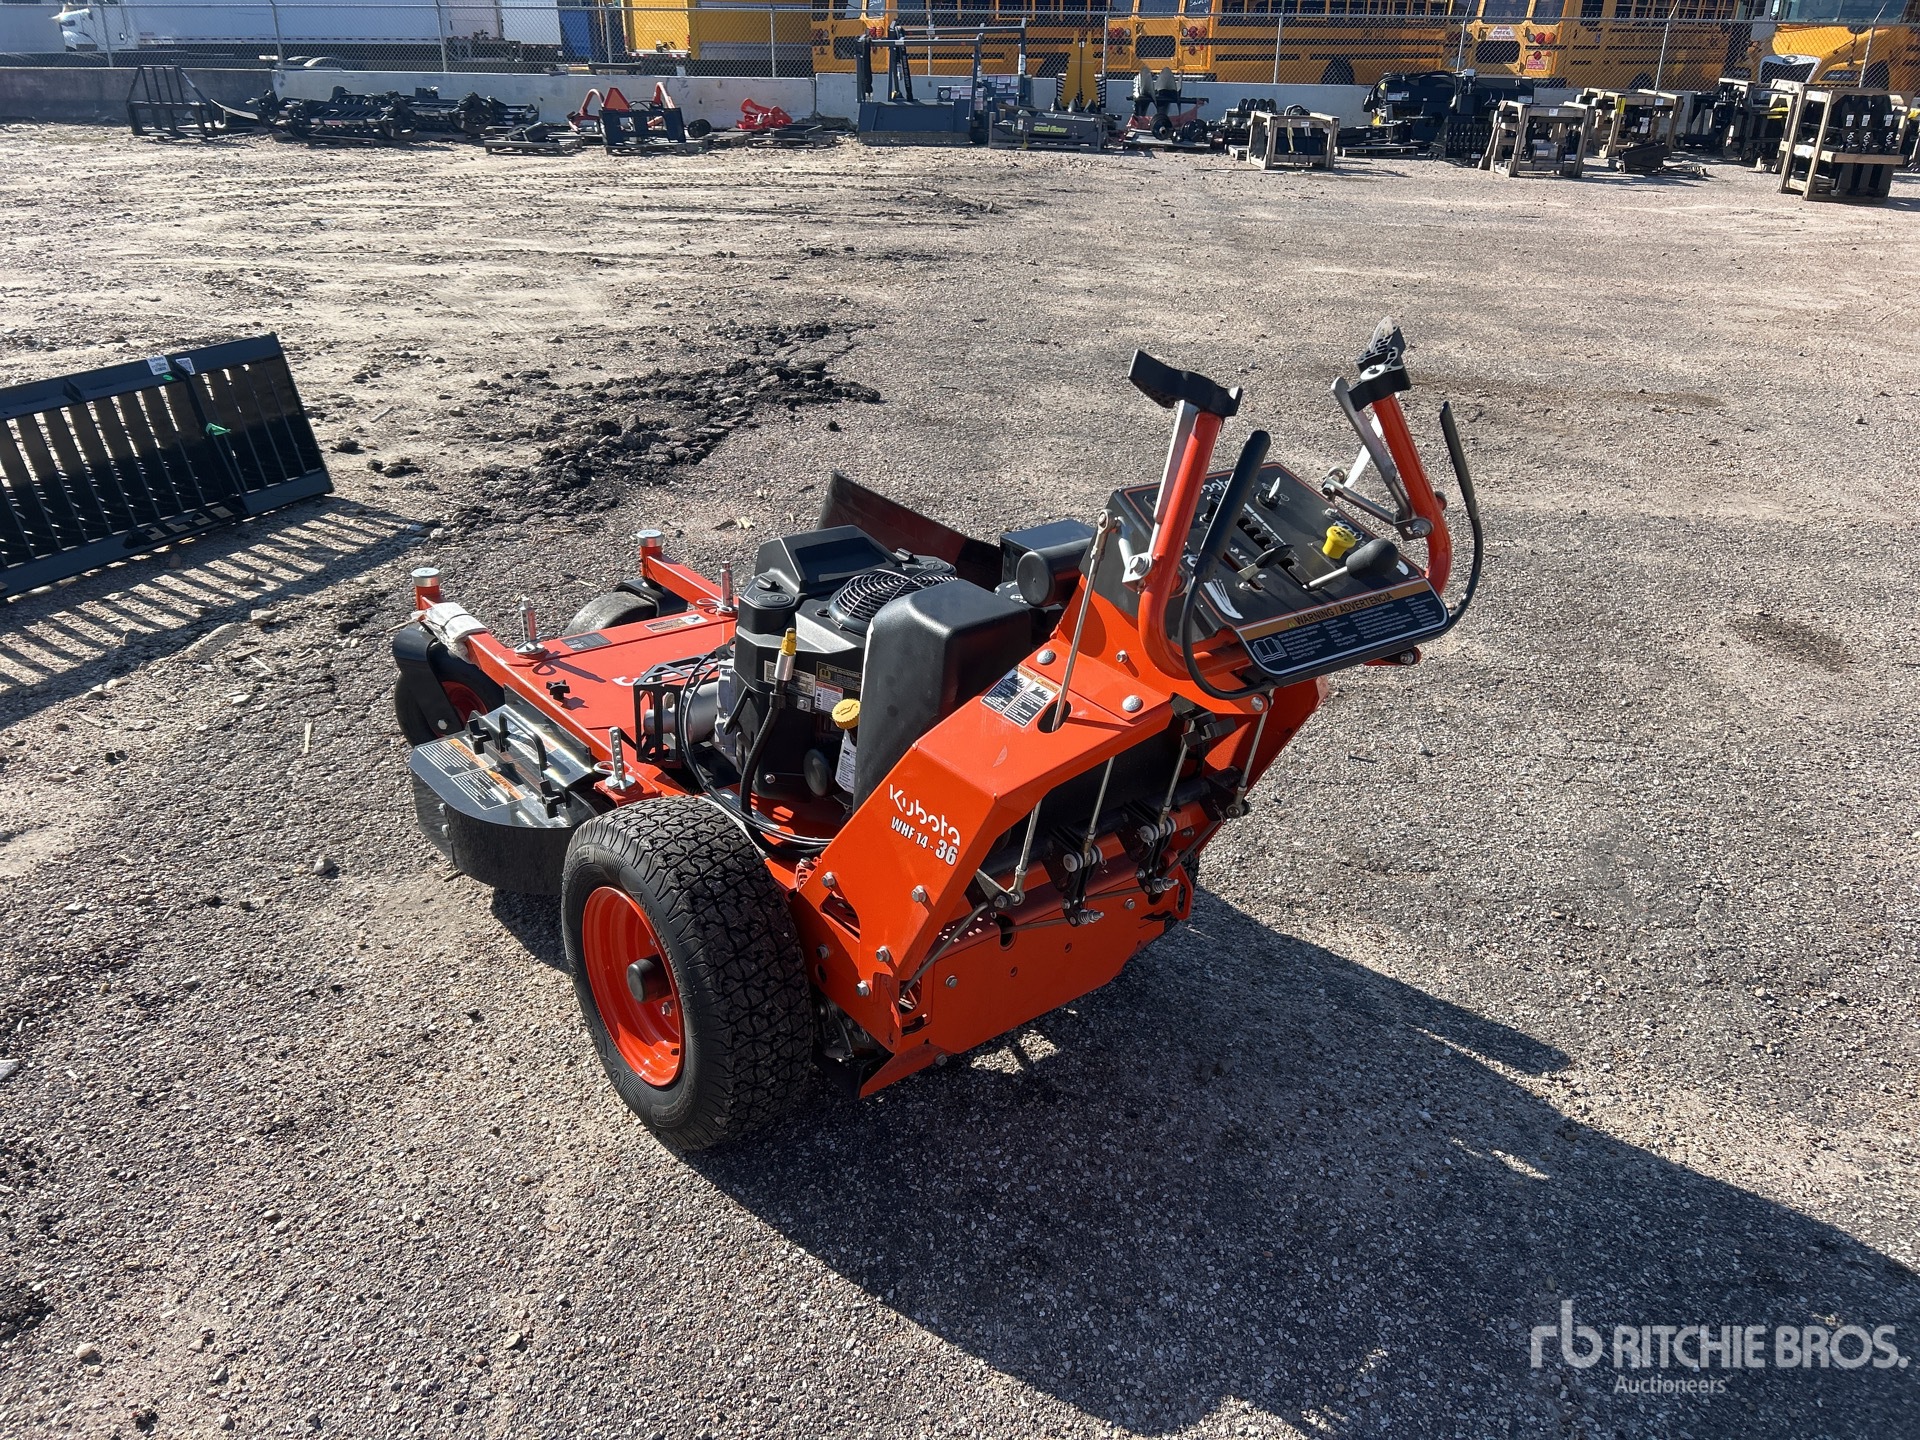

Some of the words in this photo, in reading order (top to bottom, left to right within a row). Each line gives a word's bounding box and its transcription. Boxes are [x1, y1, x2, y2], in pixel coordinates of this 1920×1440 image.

[1294, 608, 1334, 625] WARNING
[1340, 592, 1393, 613] ADVERTENCIA
[889, 783, 961, 847] Kubota
[891, 816, 916, 840] WHF
[916, 832, 929, 849] 14
[935, 839, 958, 866] 36
